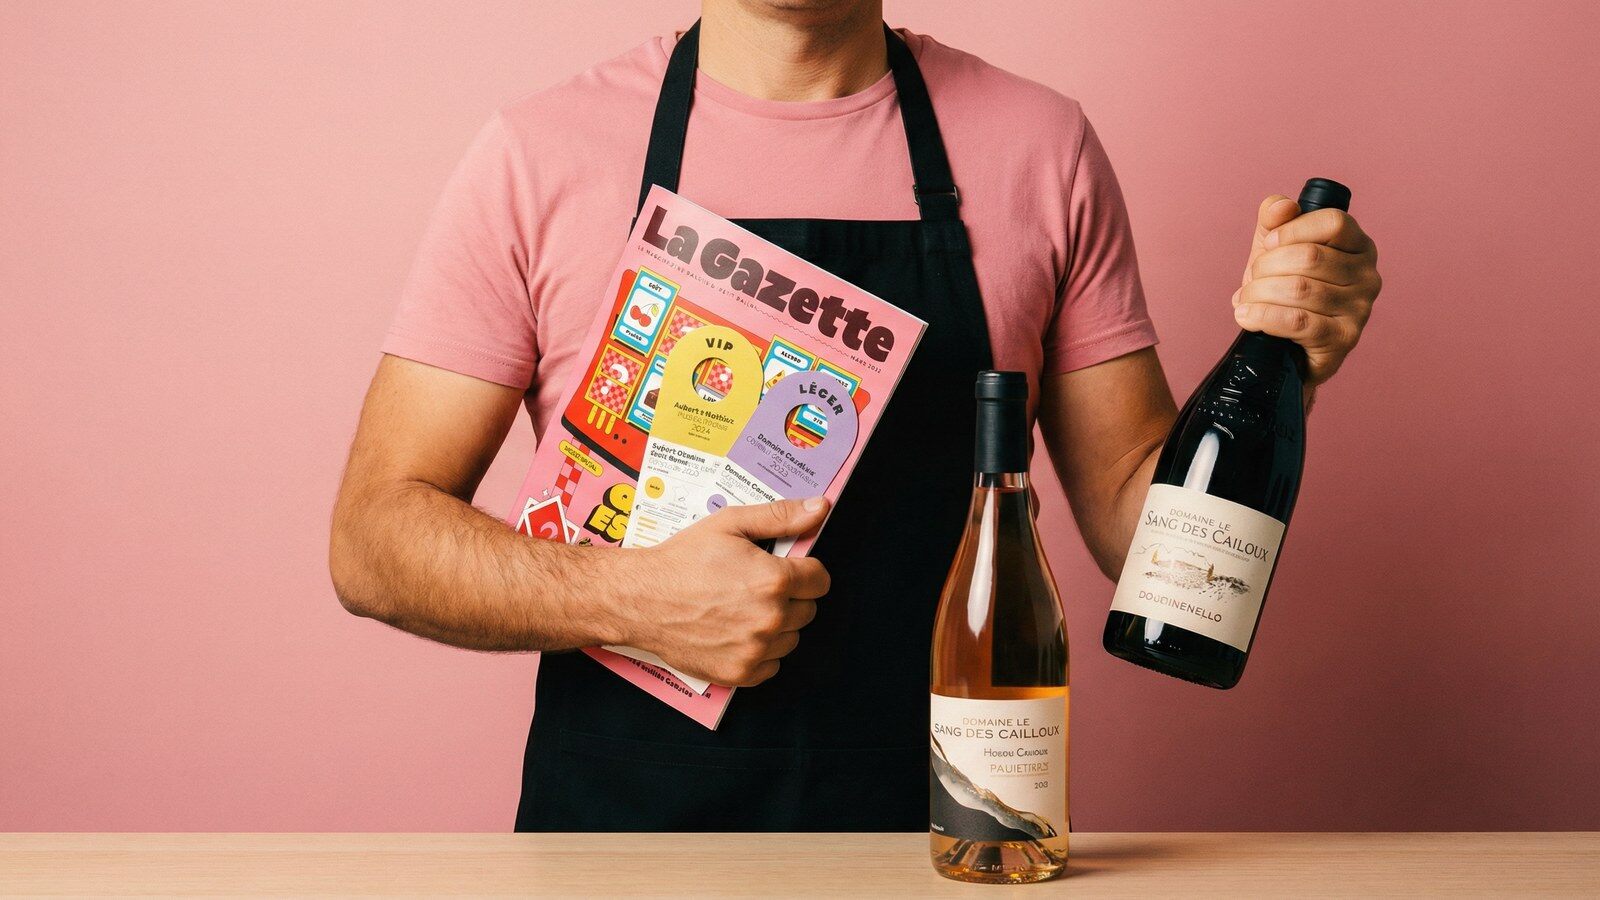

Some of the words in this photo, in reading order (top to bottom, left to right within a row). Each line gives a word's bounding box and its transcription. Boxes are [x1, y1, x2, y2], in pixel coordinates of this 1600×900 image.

[642, 204, 700, 265] La
[700, 238, 895, 363] Gazette
[705, 337, 734, 352] VIP
[1169, 508, 1215, 526] DOMAINE
[1218, 521, 1232, 532] LE
[1145, 510, 1178, 530] SANG
[1181, 523, 1208, 539] DES
[1212, 529, 1270, 562] CAILOUX
[934, 723, 962, 737] SANG
[966, 728, 994, 739] DES
[998, 725, 1060, 739] CAILLOUX
[962, 717, 1013, 727] DOMAINE
[1016, 718, 1030, 727] LE
